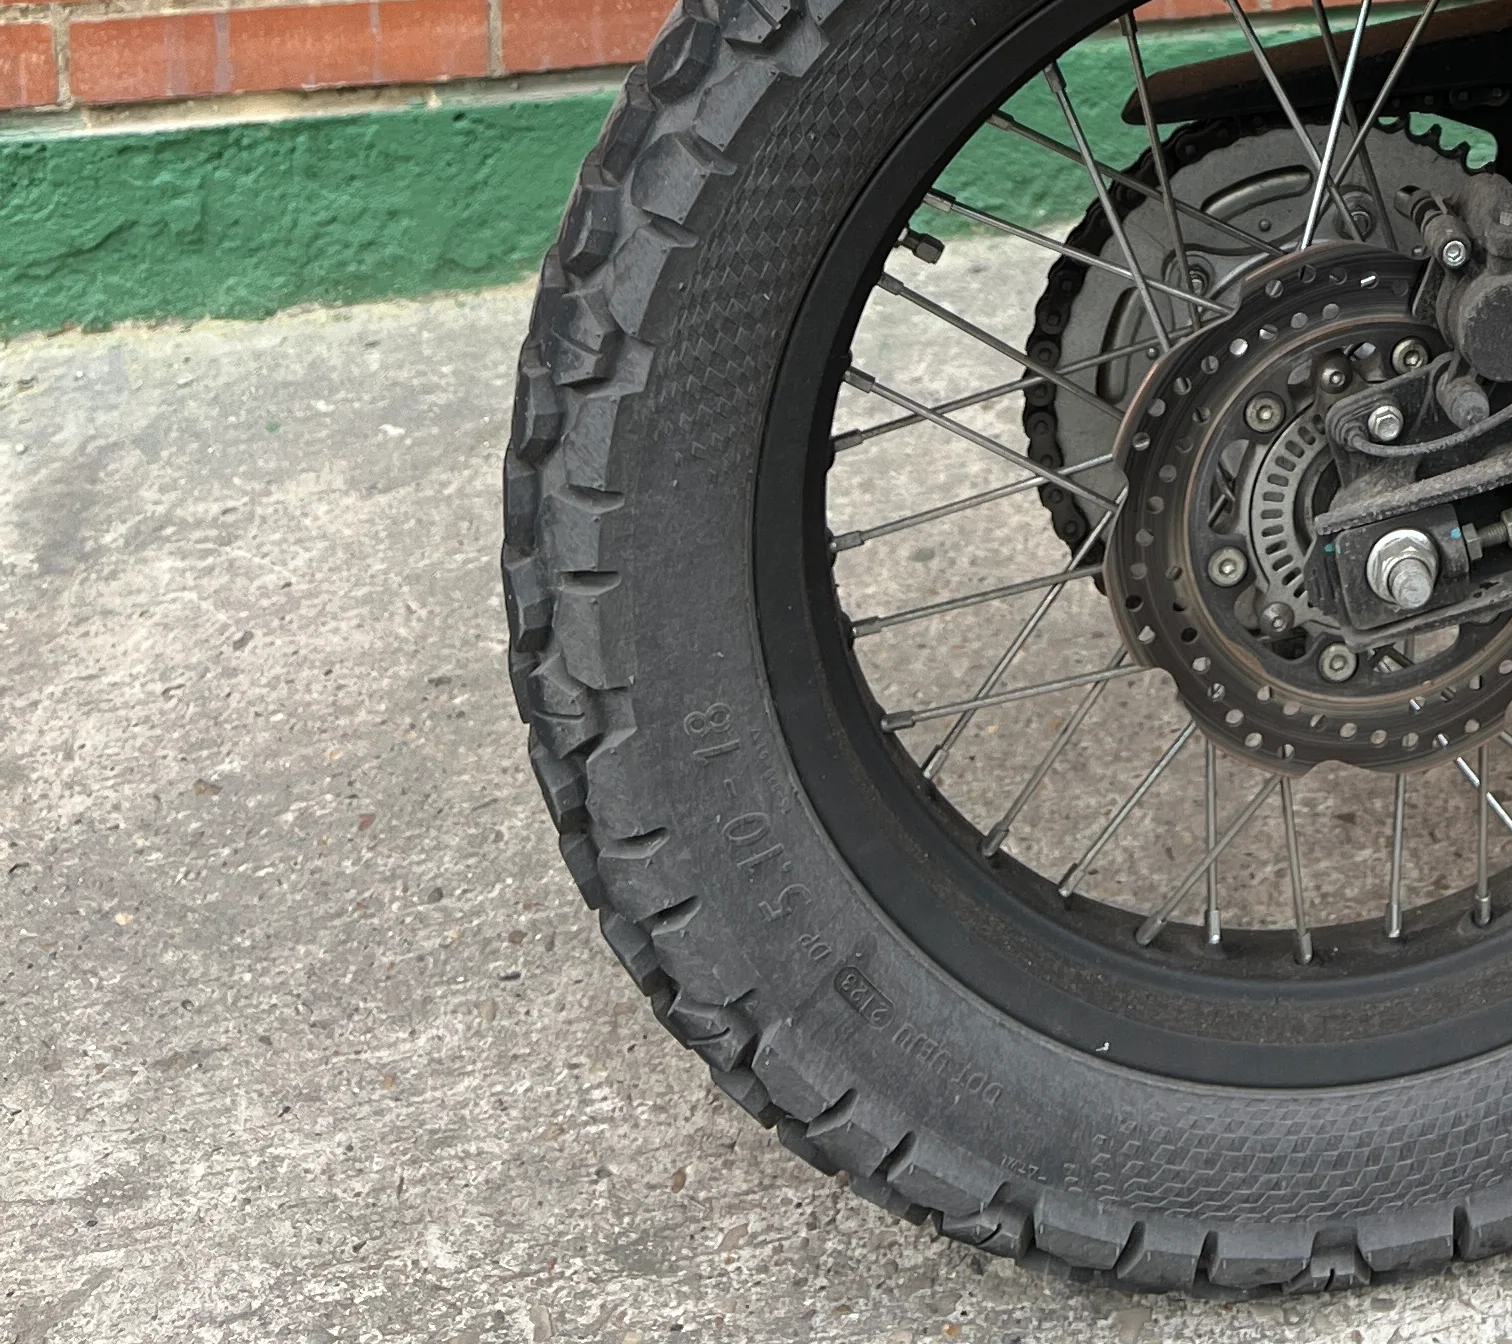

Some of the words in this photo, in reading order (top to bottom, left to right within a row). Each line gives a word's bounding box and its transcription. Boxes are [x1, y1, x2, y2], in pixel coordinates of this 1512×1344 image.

[682, 701, 741, 766] 18
[839, 972, 889, 1024] 2123
[951, 1062, 1004, 1105] DOT
